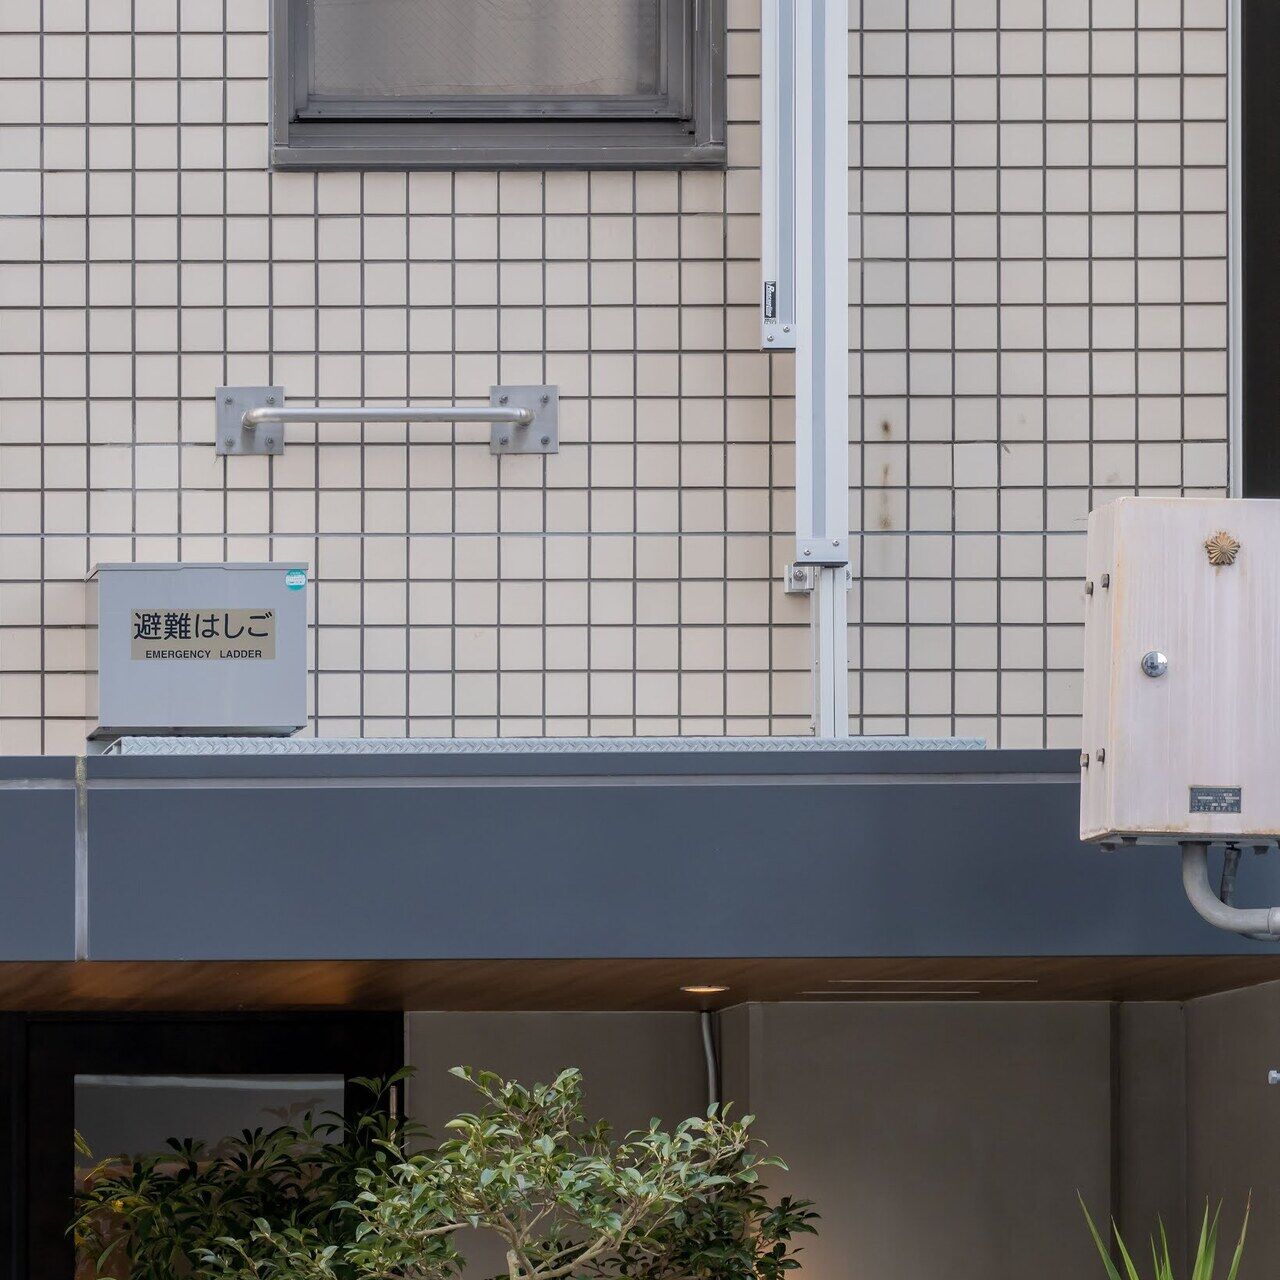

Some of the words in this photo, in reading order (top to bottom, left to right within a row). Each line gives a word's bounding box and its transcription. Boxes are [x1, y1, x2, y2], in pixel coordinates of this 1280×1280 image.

[133, 611, 273, 641] 避難はしご
[145, 649, 211, 659] EMERGENCY
[219, 649, 262, 659] LADDER
